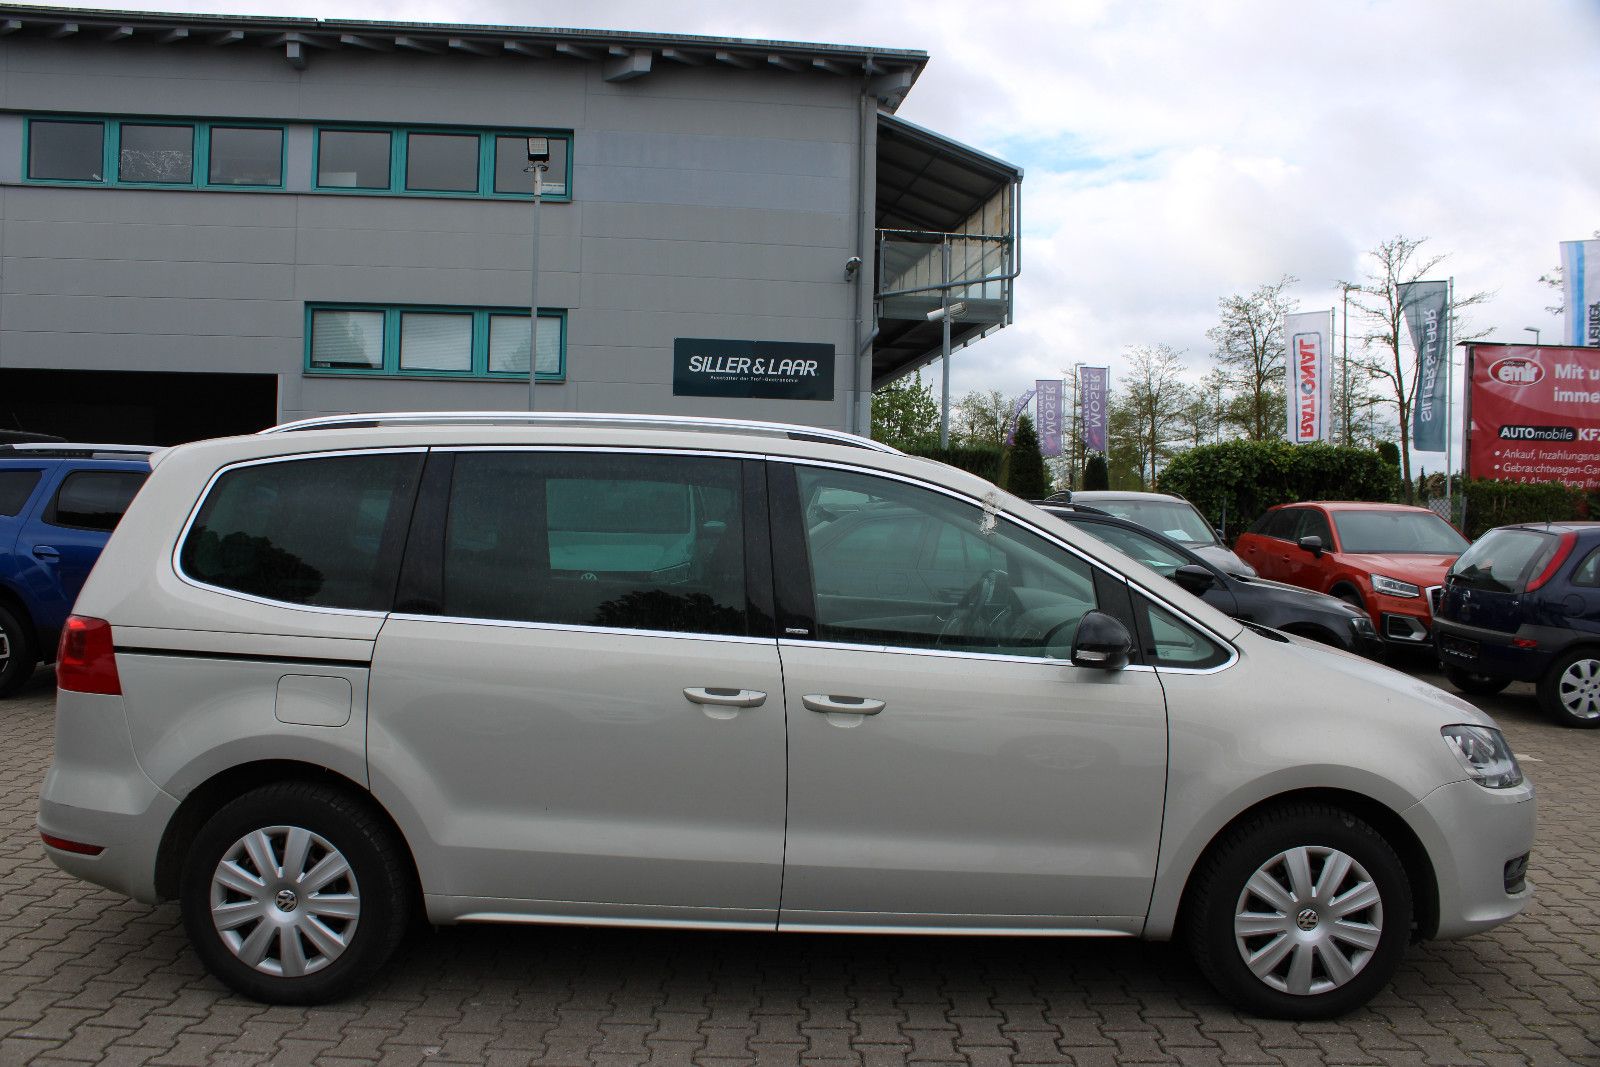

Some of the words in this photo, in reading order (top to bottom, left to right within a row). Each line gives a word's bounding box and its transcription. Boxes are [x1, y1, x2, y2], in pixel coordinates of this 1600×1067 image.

[688, 355, 752, 374] SILLER
[752, 357, 766, 375] &
[767, 358, 818, 377] LAAR
[1554, 363, 1584, 380] Mit
[1500, 426, 1573, 440] AUTOmobile
[1578, 427, 1600, 441] KF
[1502, 448, 1536, 460] Ankauf,
